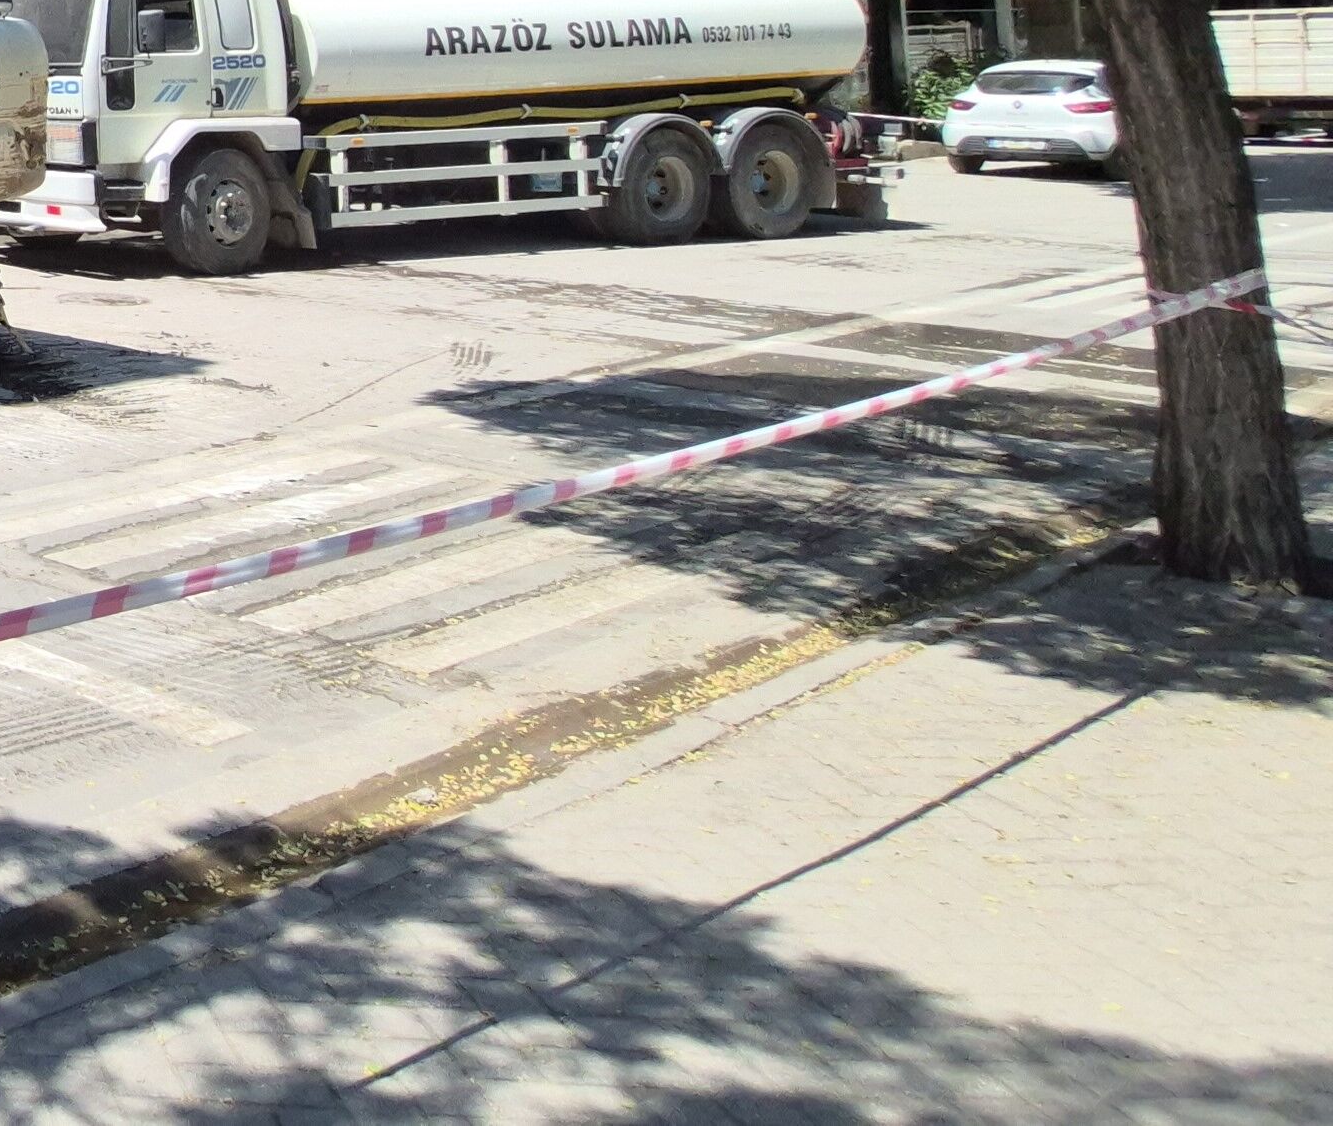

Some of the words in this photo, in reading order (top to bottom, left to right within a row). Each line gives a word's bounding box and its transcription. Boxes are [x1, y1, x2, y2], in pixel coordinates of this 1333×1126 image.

[425, 18, 552, 56] ARAZÖZ
[569, 16, 693, 49] SULAMA
[701, 25, 731, 43] 0532
[735, 24, 756, 42] 701
[760, 24, 775, 41] 74
[778, 23, 792, 40] 43
[212, 54, 267, 70] 2520
